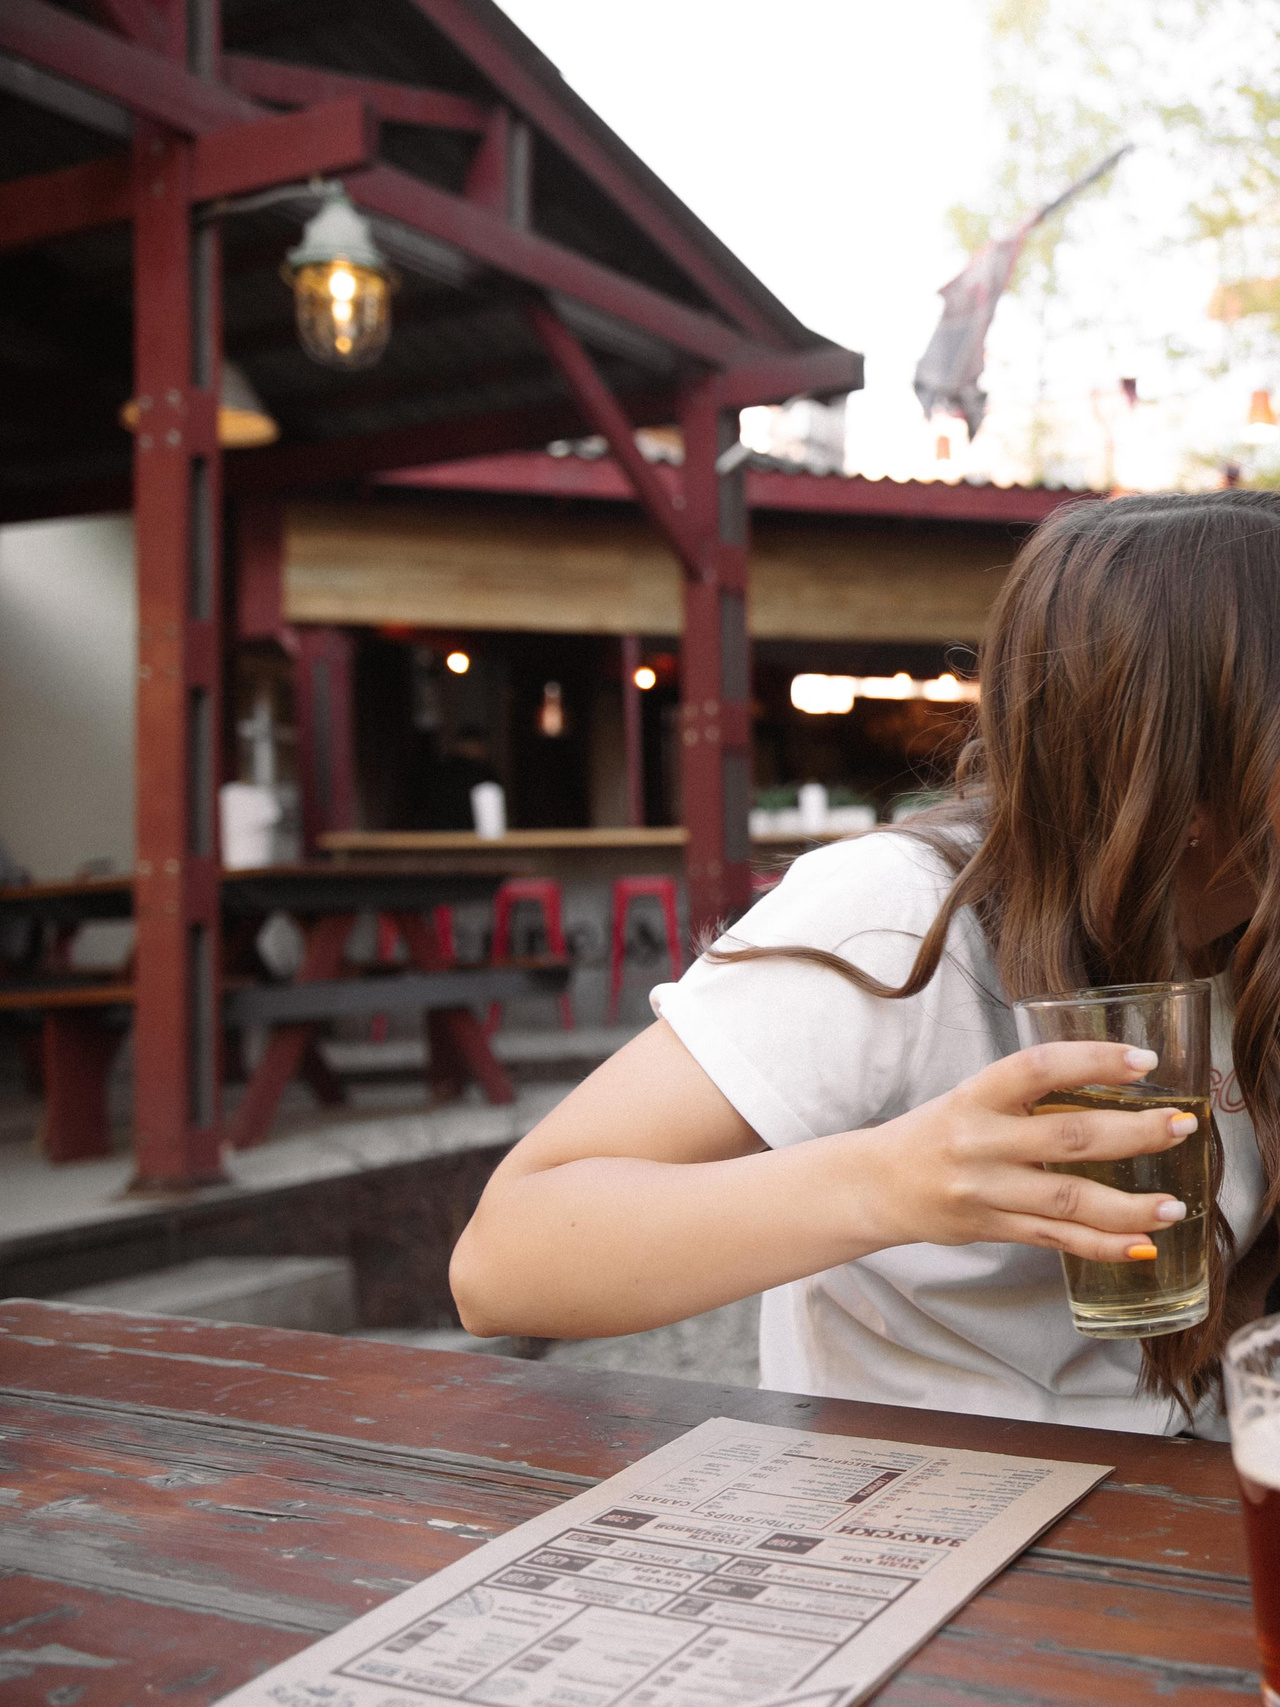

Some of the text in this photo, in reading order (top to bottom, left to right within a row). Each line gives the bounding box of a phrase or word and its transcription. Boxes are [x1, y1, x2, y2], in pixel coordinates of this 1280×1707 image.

[816, 1457, 874, 1468] ДЕСЕРТЫ
[626, 1493, 694, 1507] САЛАТЫ
[700, 1510, 809, 1530] СУПЫ/SOUPS
[833, 1525, 968, 1548] ЗАКУСКИ
